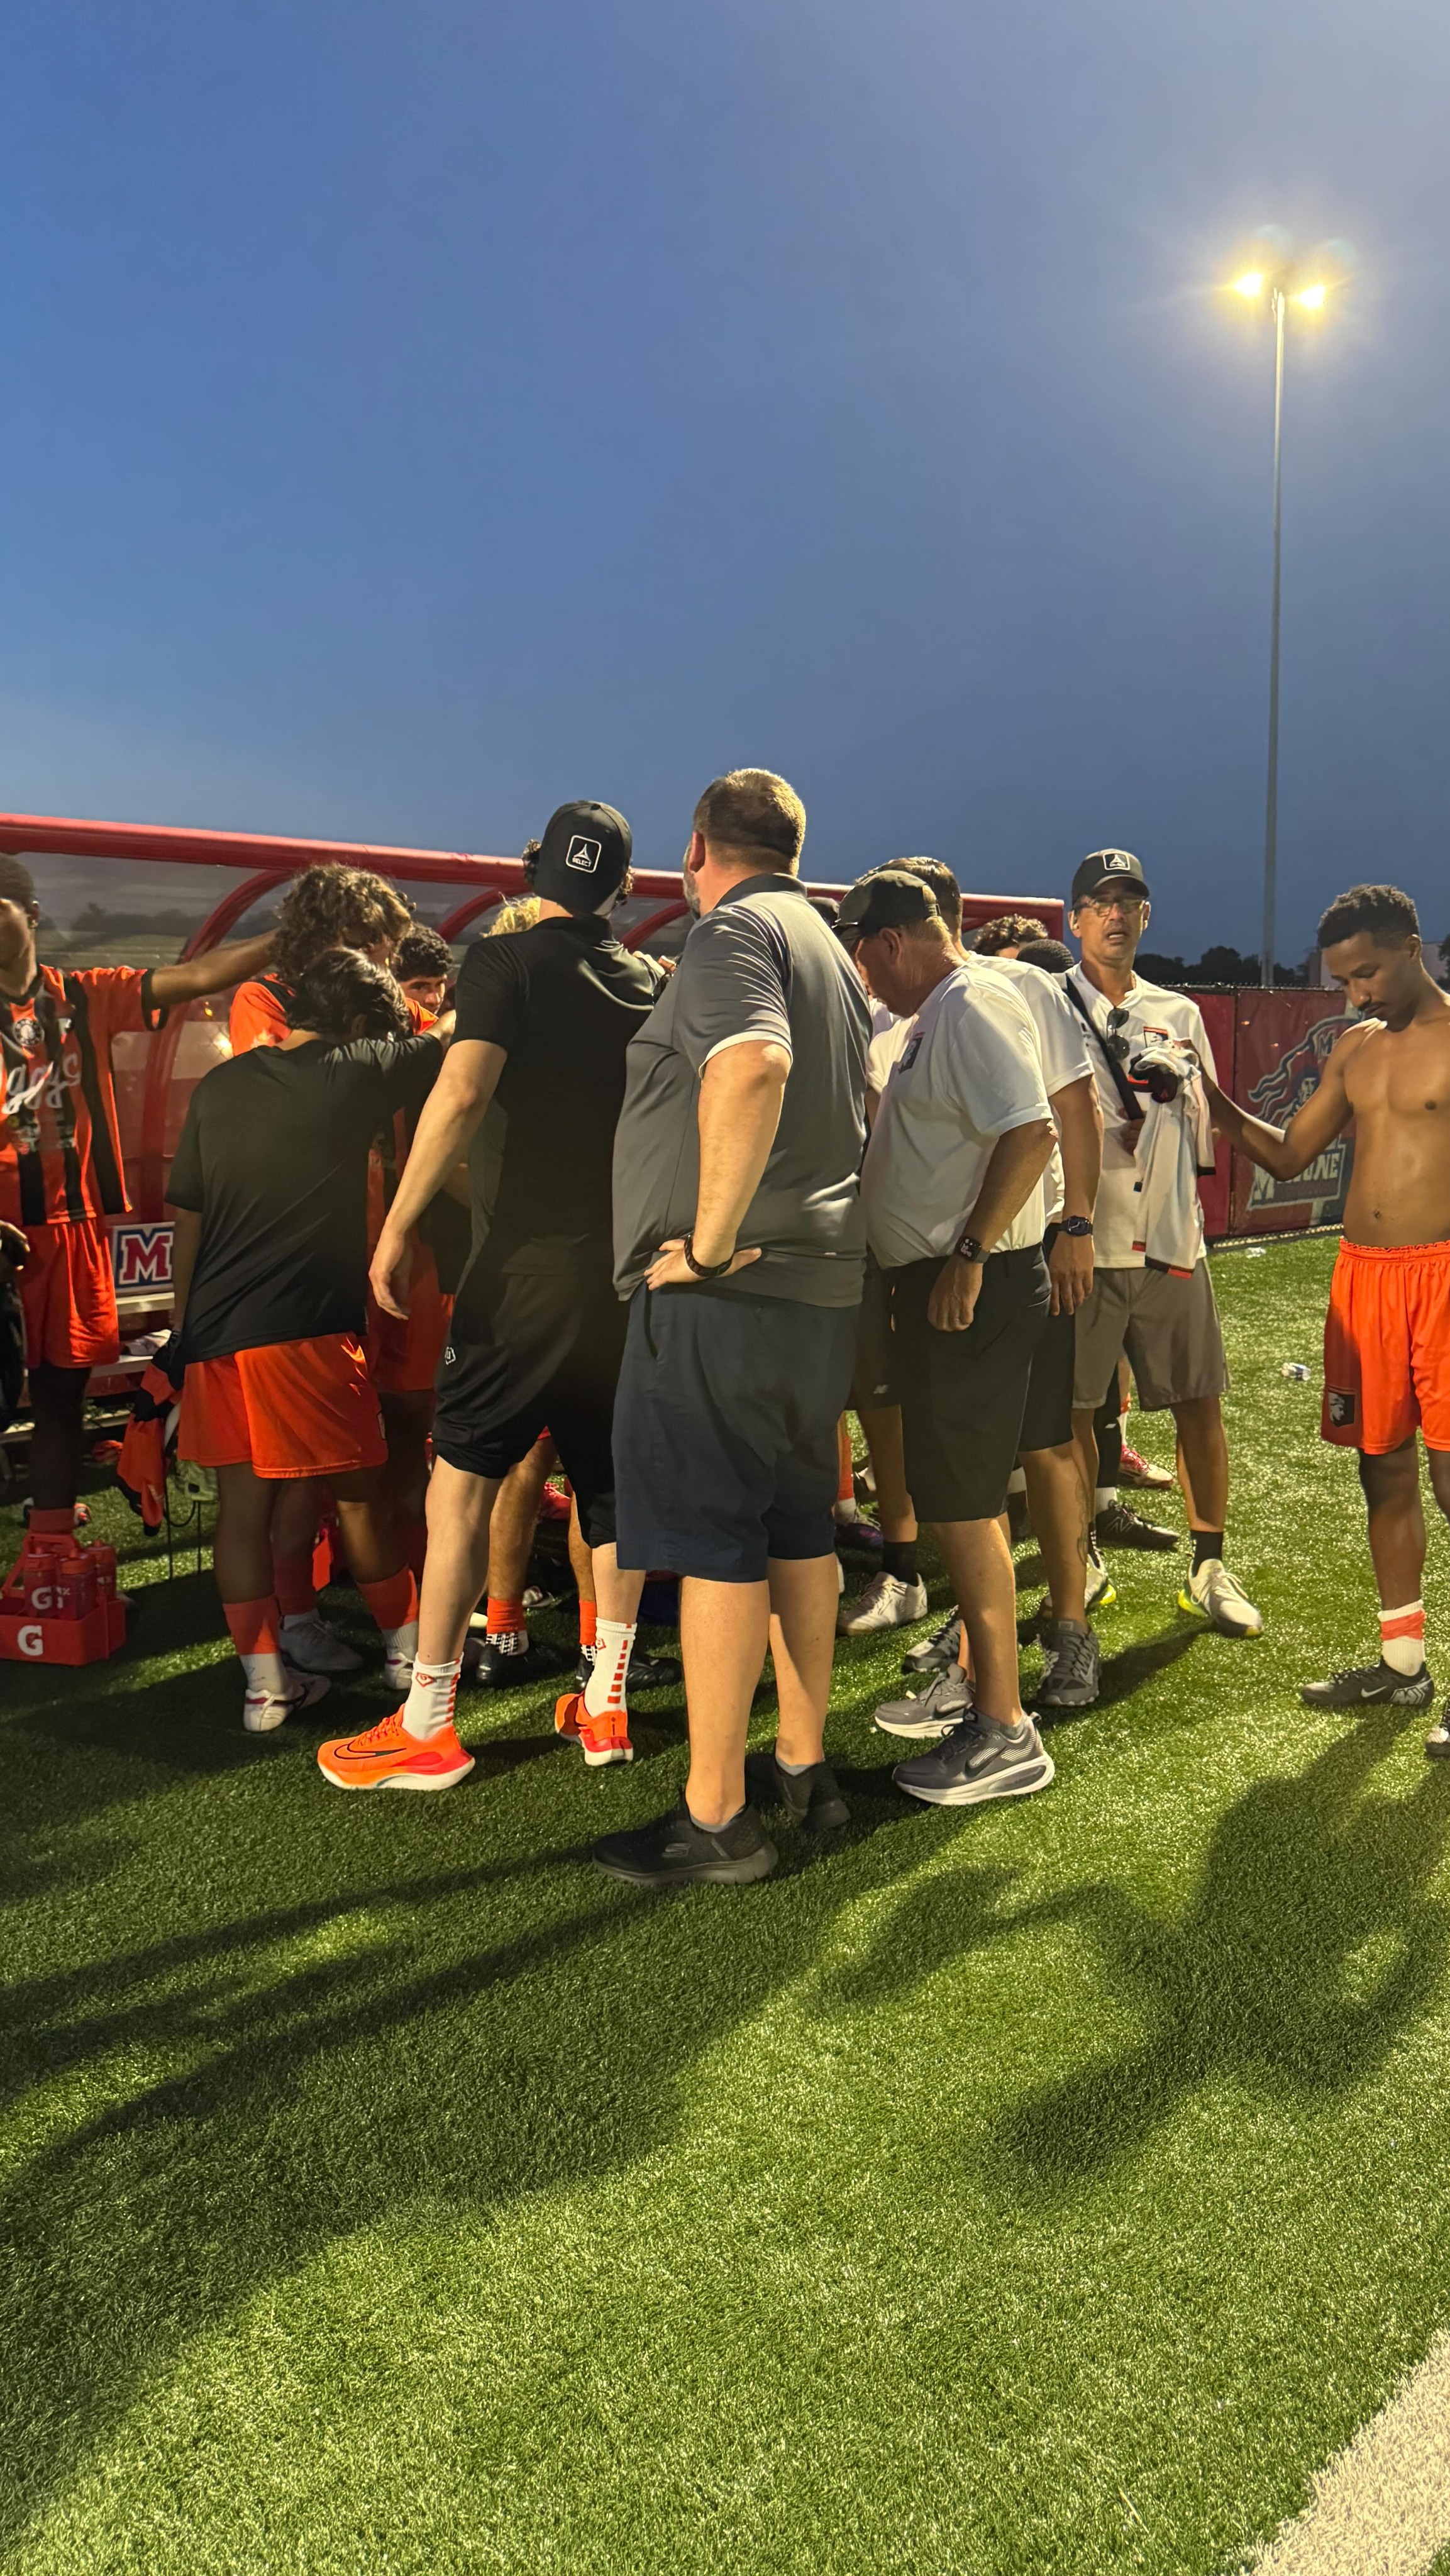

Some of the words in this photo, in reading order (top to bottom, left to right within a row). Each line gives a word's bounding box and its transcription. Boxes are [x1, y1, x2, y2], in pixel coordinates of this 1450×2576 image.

[1252, 1152, 1341, 1201] MONE
[119, 1231, 174, 1285] M
[31, 1586, 53, 1610] G
[18, 1625, 43, 1656] G
